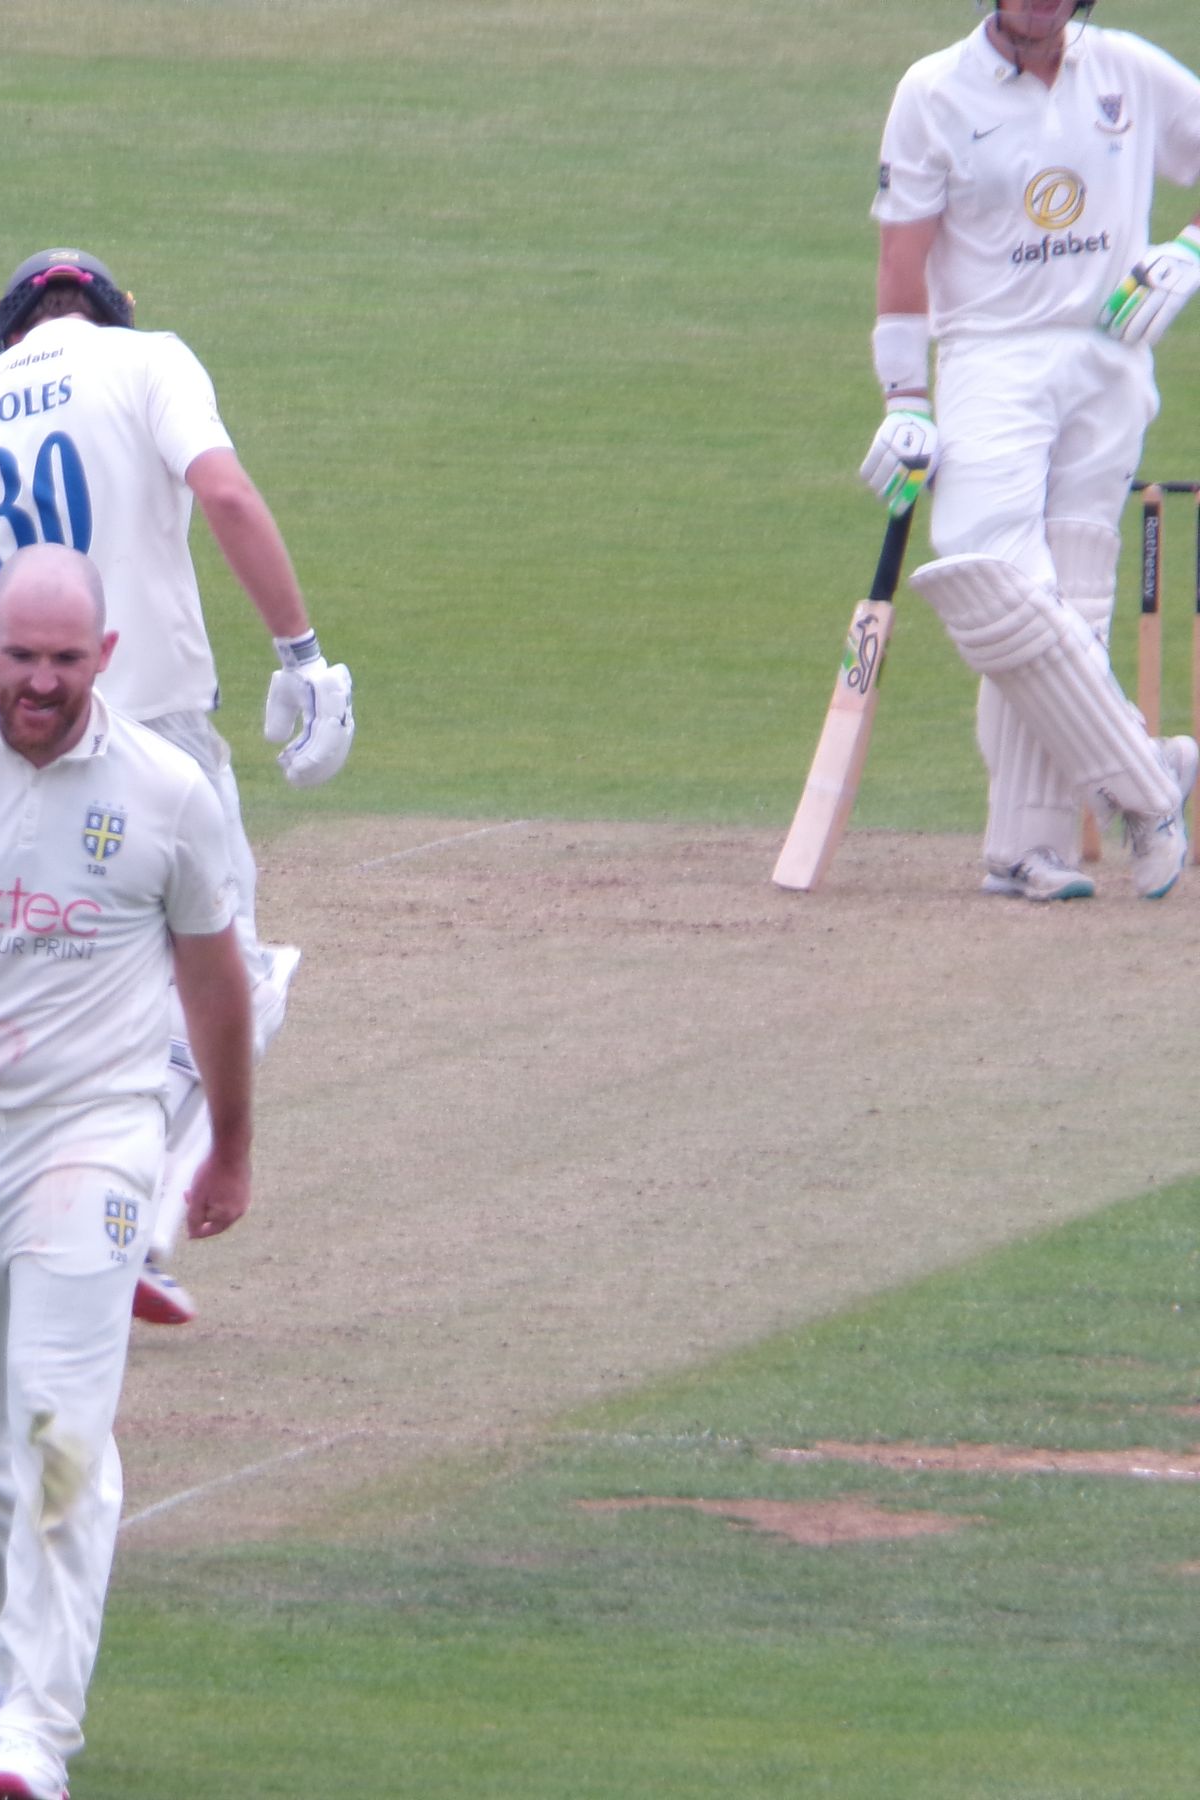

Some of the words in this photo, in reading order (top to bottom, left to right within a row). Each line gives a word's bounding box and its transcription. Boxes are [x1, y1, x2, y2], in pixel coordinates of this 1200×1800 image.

[1011, 230, 1110, 265] dafabet
[9, 347, 64, 370] dafabet
[1143, 516, 1159, 597] Rothesay
[33, 937, 97, 960] PRINT
